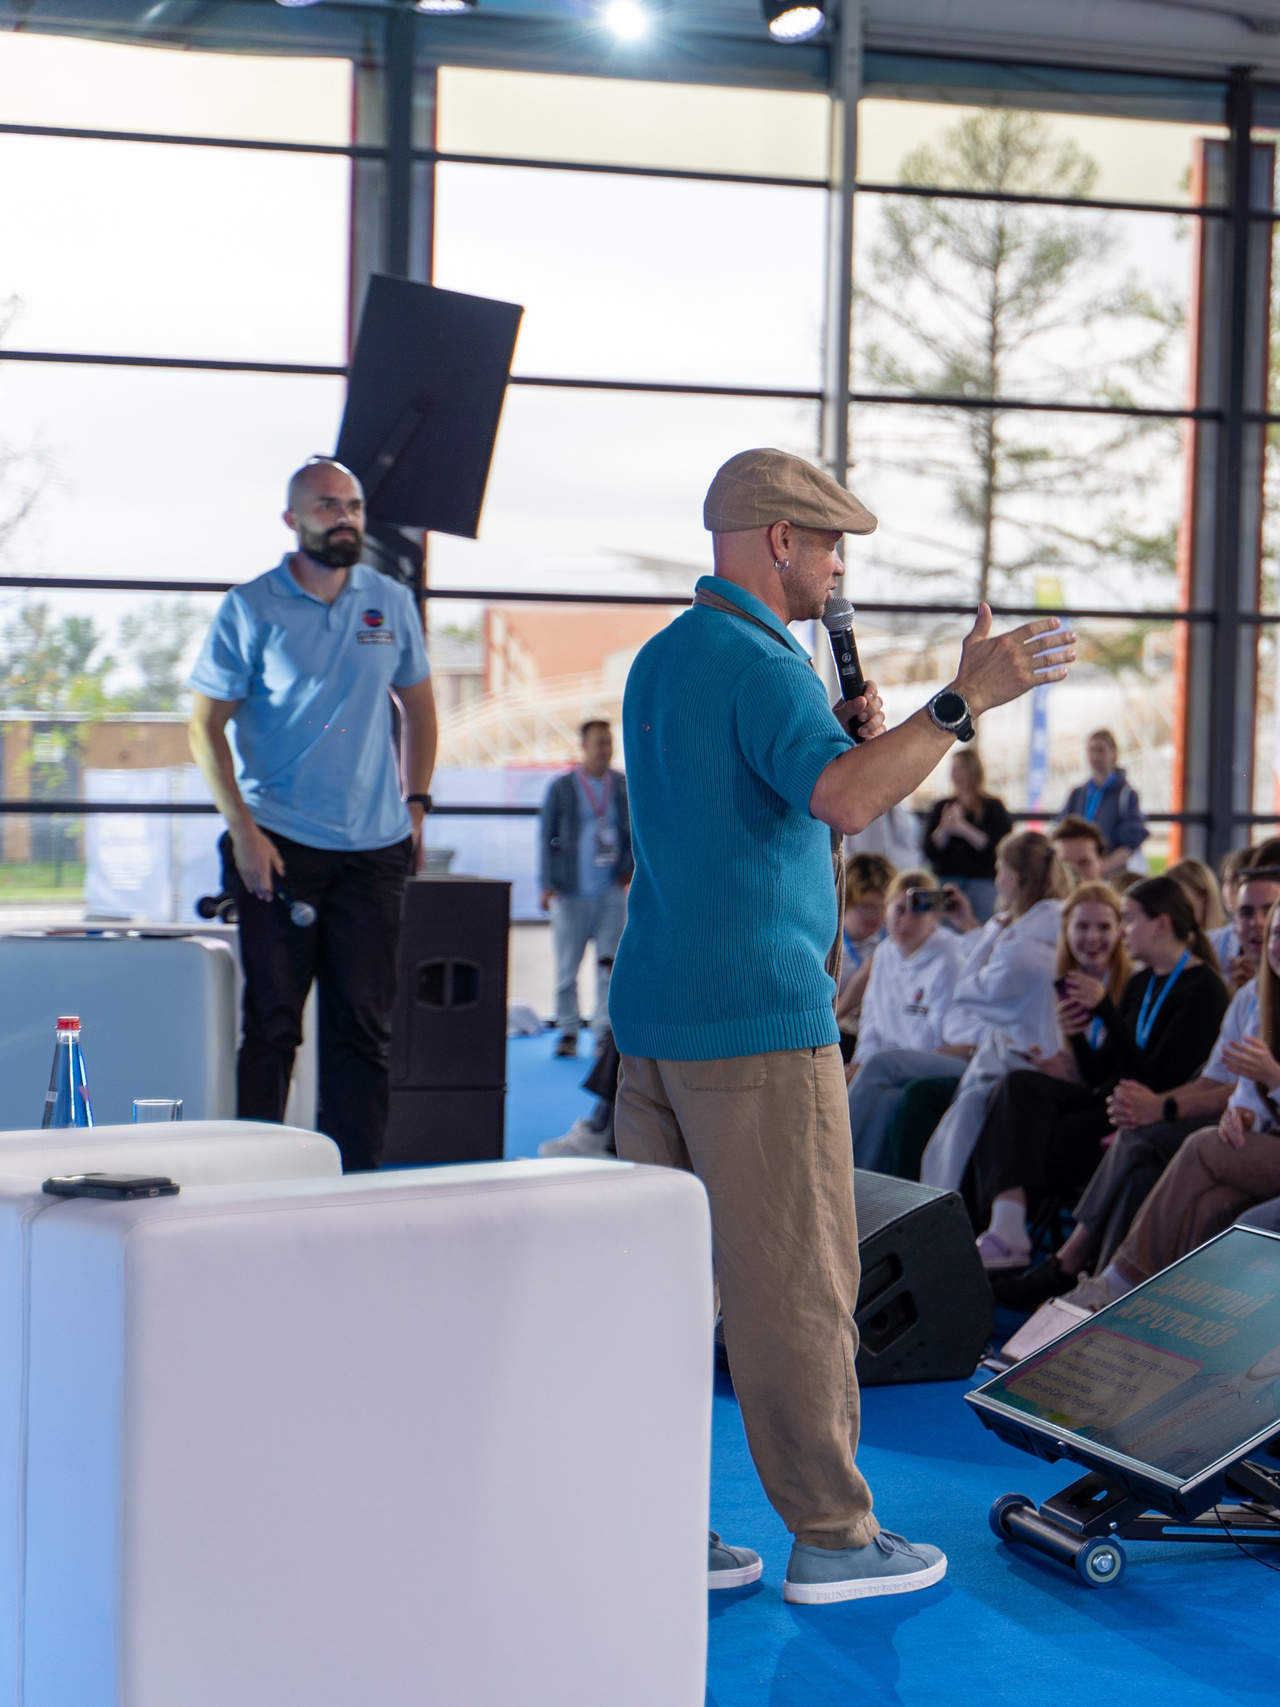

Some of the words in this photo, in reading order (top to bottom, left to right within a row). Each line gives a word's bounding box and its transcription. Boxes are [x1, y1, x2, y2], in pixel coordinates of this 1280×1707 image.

[1146, 1272, 1275, 1319] ДМИТРИЙ
[1114, 1297, 1239, 1347] ХРУСТАЛЁВ
[817, 1586, 866, 1601] PRINCIPE
